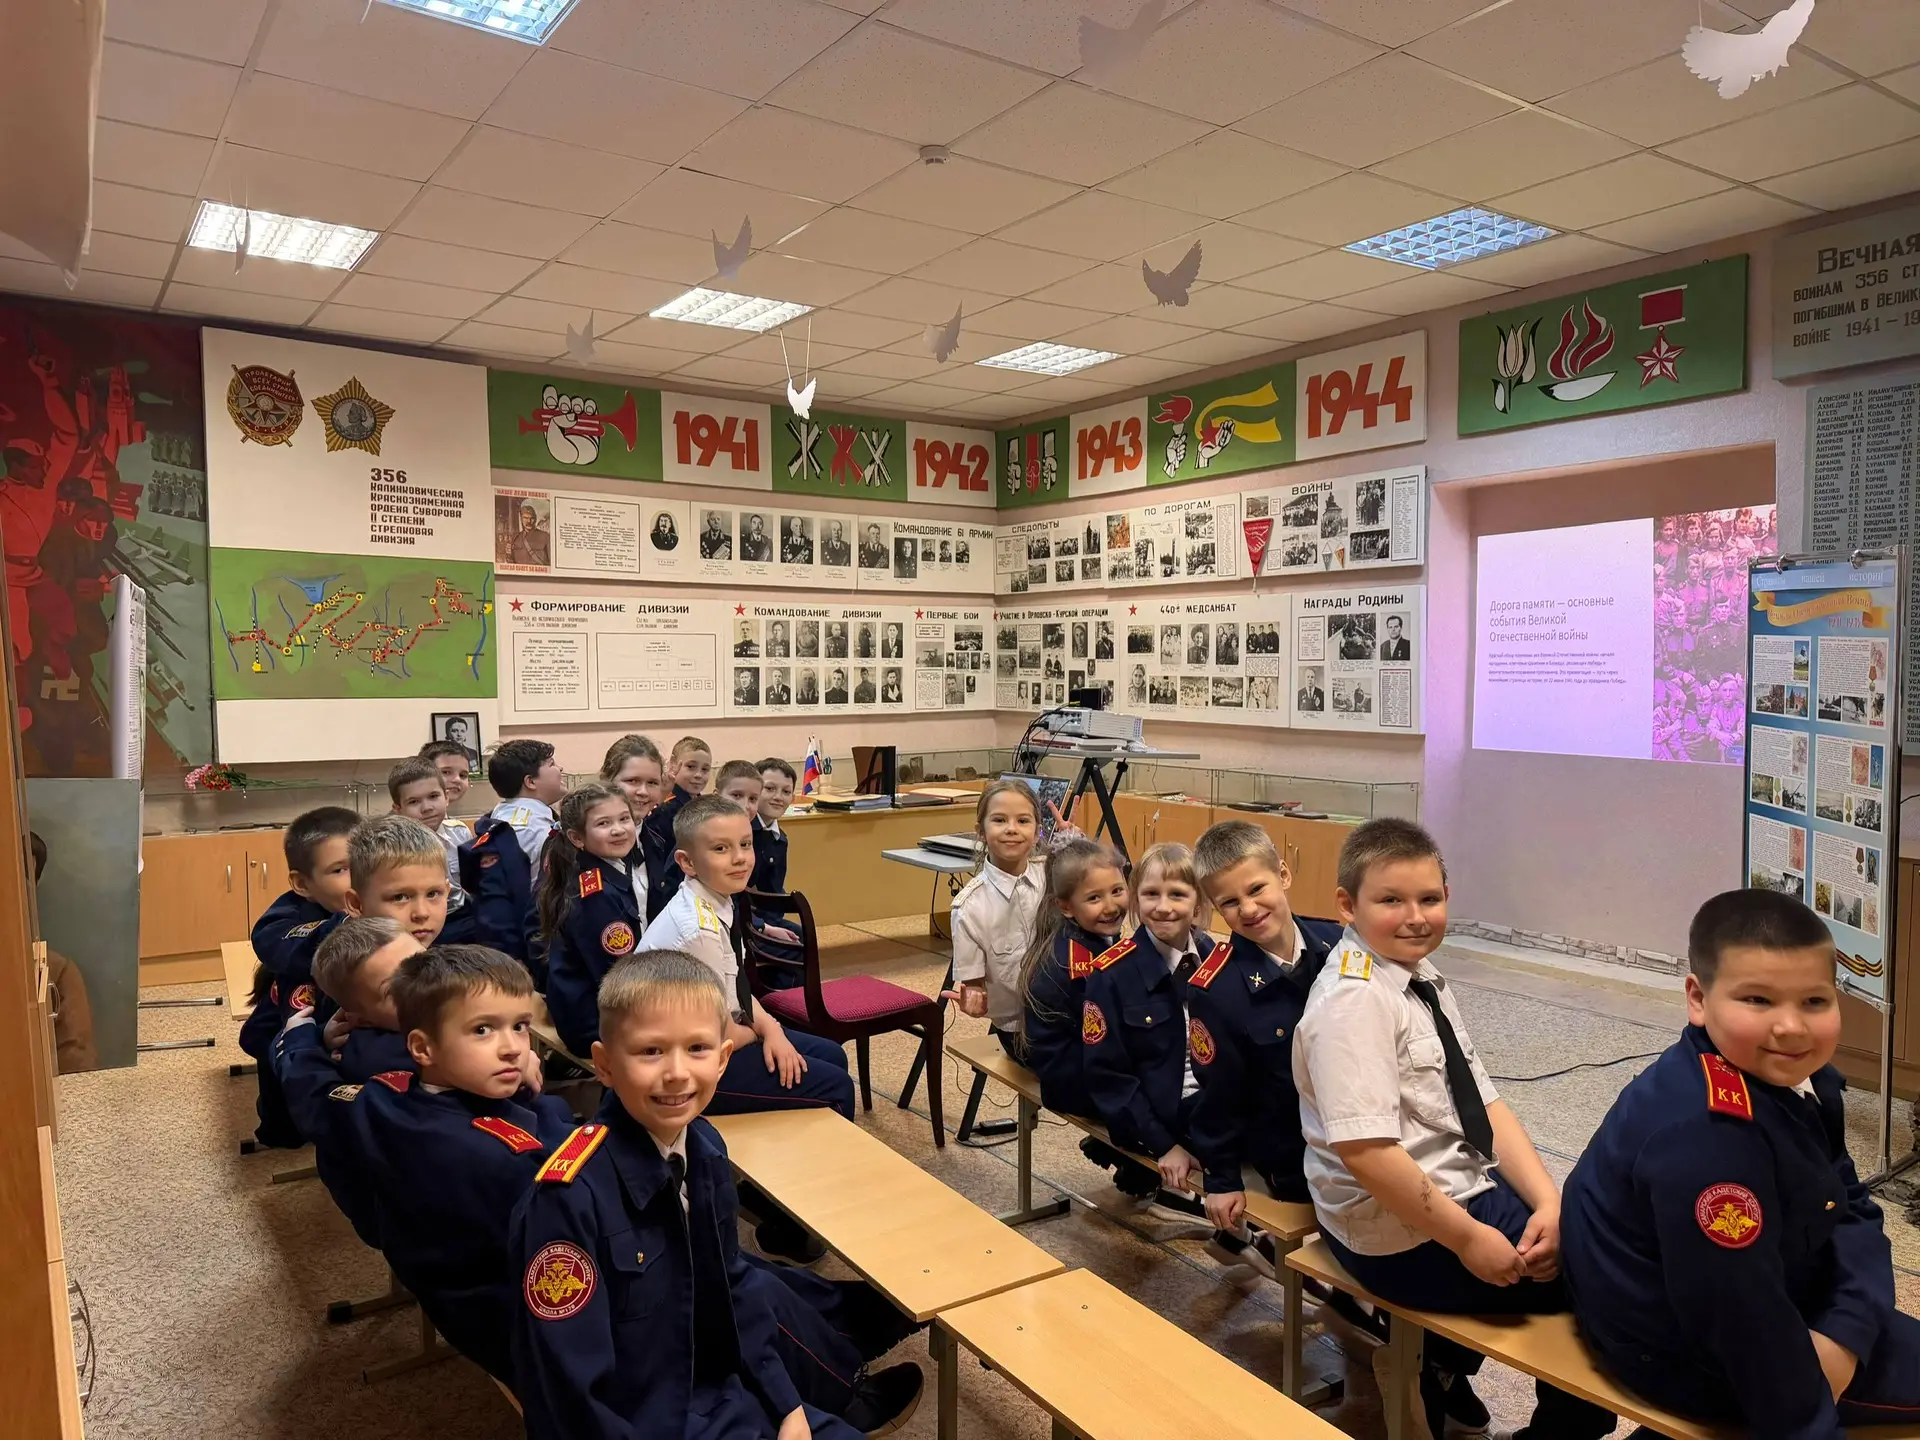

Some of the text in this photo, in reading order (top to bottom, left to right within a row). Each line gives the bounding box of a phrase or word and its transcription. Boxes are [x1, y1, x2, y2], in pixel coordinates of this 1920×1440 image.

[1817, 233, 1920, 274] ВЕЧНАЯ
[1793, 281, 1843, 302] ВОИНАМ
[1855, 269, 1889, 289] 356
[1793, 288, 1920, 325] ПОГИБШИМ В ВЕЛИК
[1793, 328, 1831, 347] ВОЙНЕ
[1846, 317, 1881, 337] 1941
[252, 377, 270, 385] ВСЕХ
[1306, 355, 1413, 440] 1944
[673, 410, 761, 473] 1941
[1076, 416, 1144, 481] 1943
[913, 438, 990, 493] 1942
[370, 468, 407, 484] 356
[370, 482, 464, 499] КАЛИНКОВИЧЕСКАЯ
[1291, 481, 1333, 496] ВОЙНЫ
[370, 492, 465, 509] КРАСНОЗНАМЕННАЯ
[370, 503, 462, 518] ОРДЕНА СУВОРОВА
[1144, 500, 1211, 516] ПО ДОРОГАМ
[381, 515, 425, 526] СТЕПЕНИ
[1011, 520, 1060, 534] СЛЕДОПЫТЫ
[370, 524, 434, 536] СТРЕЛКОВАЯ
[893, 522, 952, 536] КОМАНДОВАНИЕ
[969, 529, 993, 539] АРМИИ
[370, 534, 415, 545] ДИВИЗИЯ
[1801, 572, 1825, 583] нашей
[1849, 570, 1883, 583] истории
[530, 600, 690, 614] ФОРМИРОВАНИЕ ДИВИЗИИ
[1185, 603, 1236, 614] МЕДСАНБАТ
[1304, 594, 1404, 609] НАГРАДЫ РОДИНЫ
[1490, 600, 1521, 614] Дорога
[1522, 598, 1555, 610] памяти
[1567, 595, 1614, 607] основные
[754, 606, 882, 619] КОМАНДОВАНИЕ ДИВИЗИИ
[926, 611, 979, 620] ПЕРВЫЕ БОИ
[999, 611, 1020, 620] УЧАСТИЕ
[1081, 608, 1109, 618] ОПЕРАЦИИ
[1490, 613, 1567, 627] события Великой
[1489, 628, 1588, 642] Отечественной войны
[585, 883, 597, 892] КК
[1075, 962, 1089, 971] КК
[1196, 968, 1212, 979] КК
[549, 1159, 574, 1171] КК
[529, 1247, 591, 1284] САМАРСКИЙ КАДЕТСКИЙ КОРПУС
[538, 1305, 558, 1315] ШКОЛА
